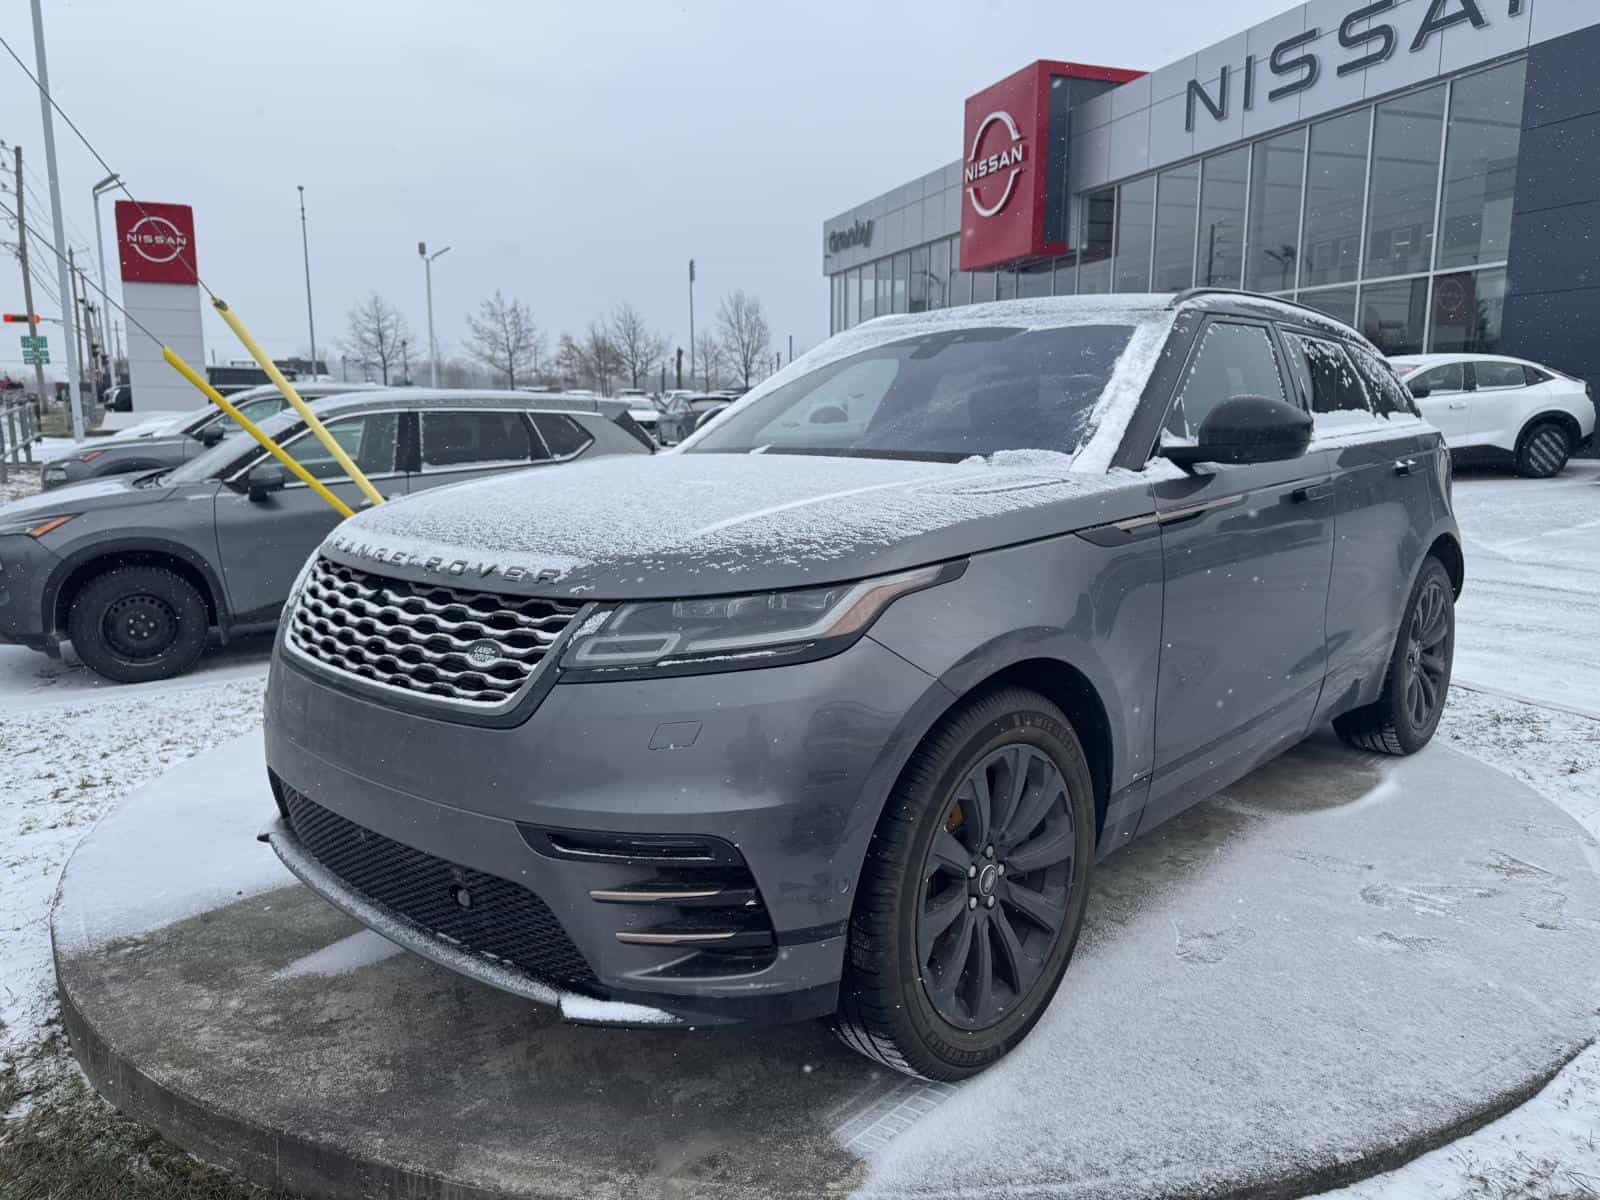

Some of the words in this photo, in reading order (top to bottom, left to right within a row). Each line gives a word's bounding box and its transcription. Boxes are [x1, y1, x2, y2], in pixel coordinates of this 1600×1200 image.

[1185, 0, 1521, 132] NISSA
[965, 144, 1023, 184] NISSAN
[126, 233, 187, 246] NISSAN
[423, 556, 561, 584] ROVER
